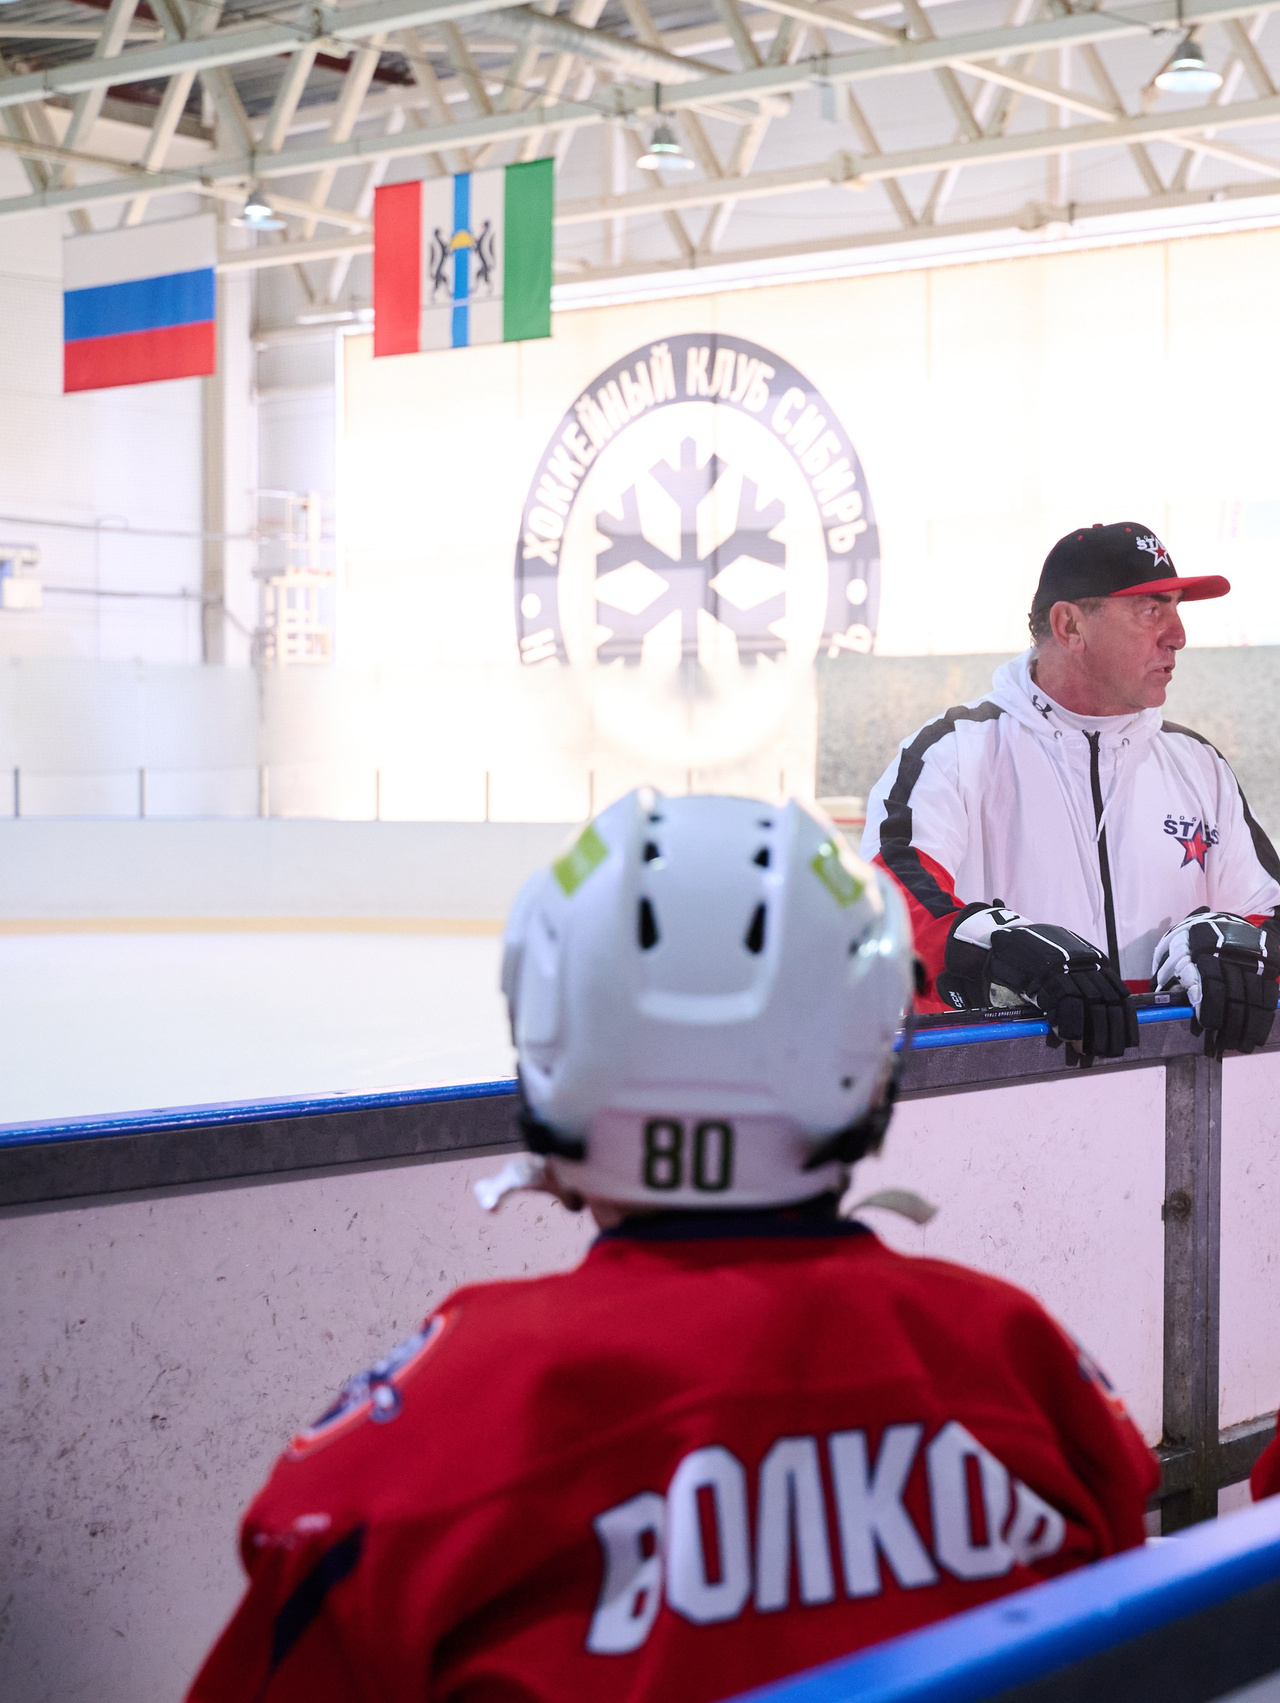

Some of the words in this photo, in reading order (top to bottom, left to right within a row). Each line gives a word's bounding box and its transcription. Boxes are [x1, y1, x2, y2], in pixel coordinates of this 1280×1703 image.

[522, 342, 677, 566] ХОККЕЙНЫЙ
[685, 346, 775, 413] КЛУБ
[771, 387, 868, 554] СИБИРЬ
[643, 1117, 734, 1192] 80
